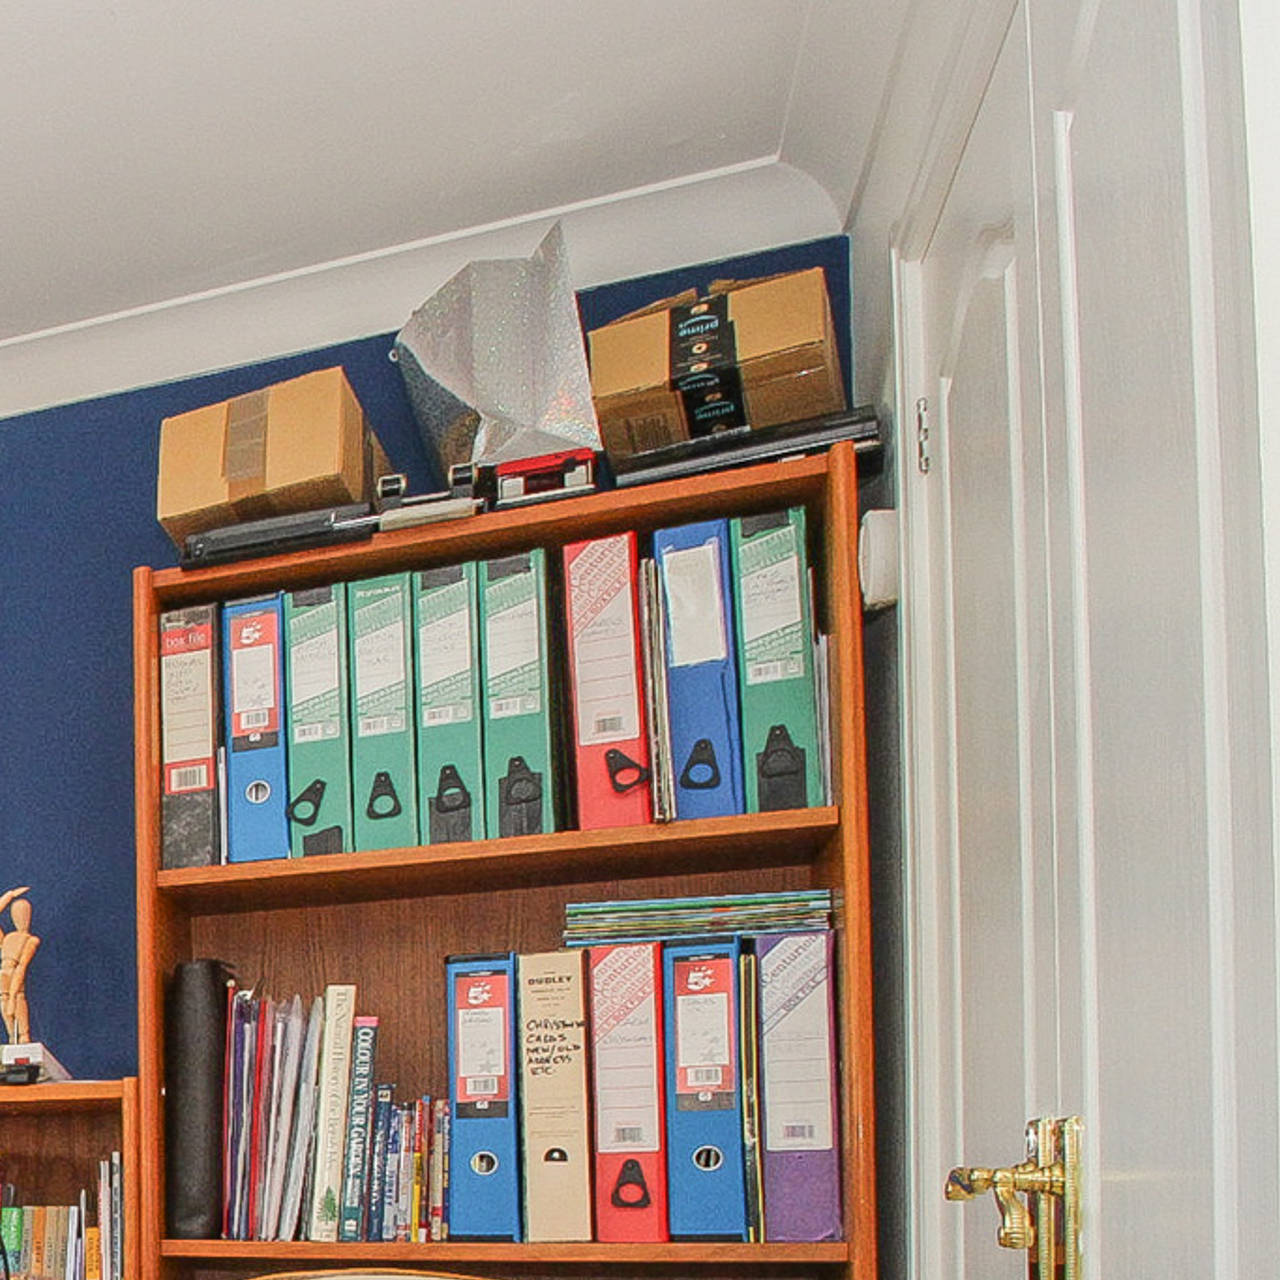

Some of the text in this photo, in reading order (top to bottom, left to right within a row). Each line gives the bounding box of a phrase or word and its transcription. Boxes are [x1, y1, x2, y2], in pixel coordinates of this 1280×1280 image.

[354, 1028, 374, 1077] COLOUR
[351, 1092, 368, 1126] YOUR
[347, 1127, 366, 1178] GARDEN
